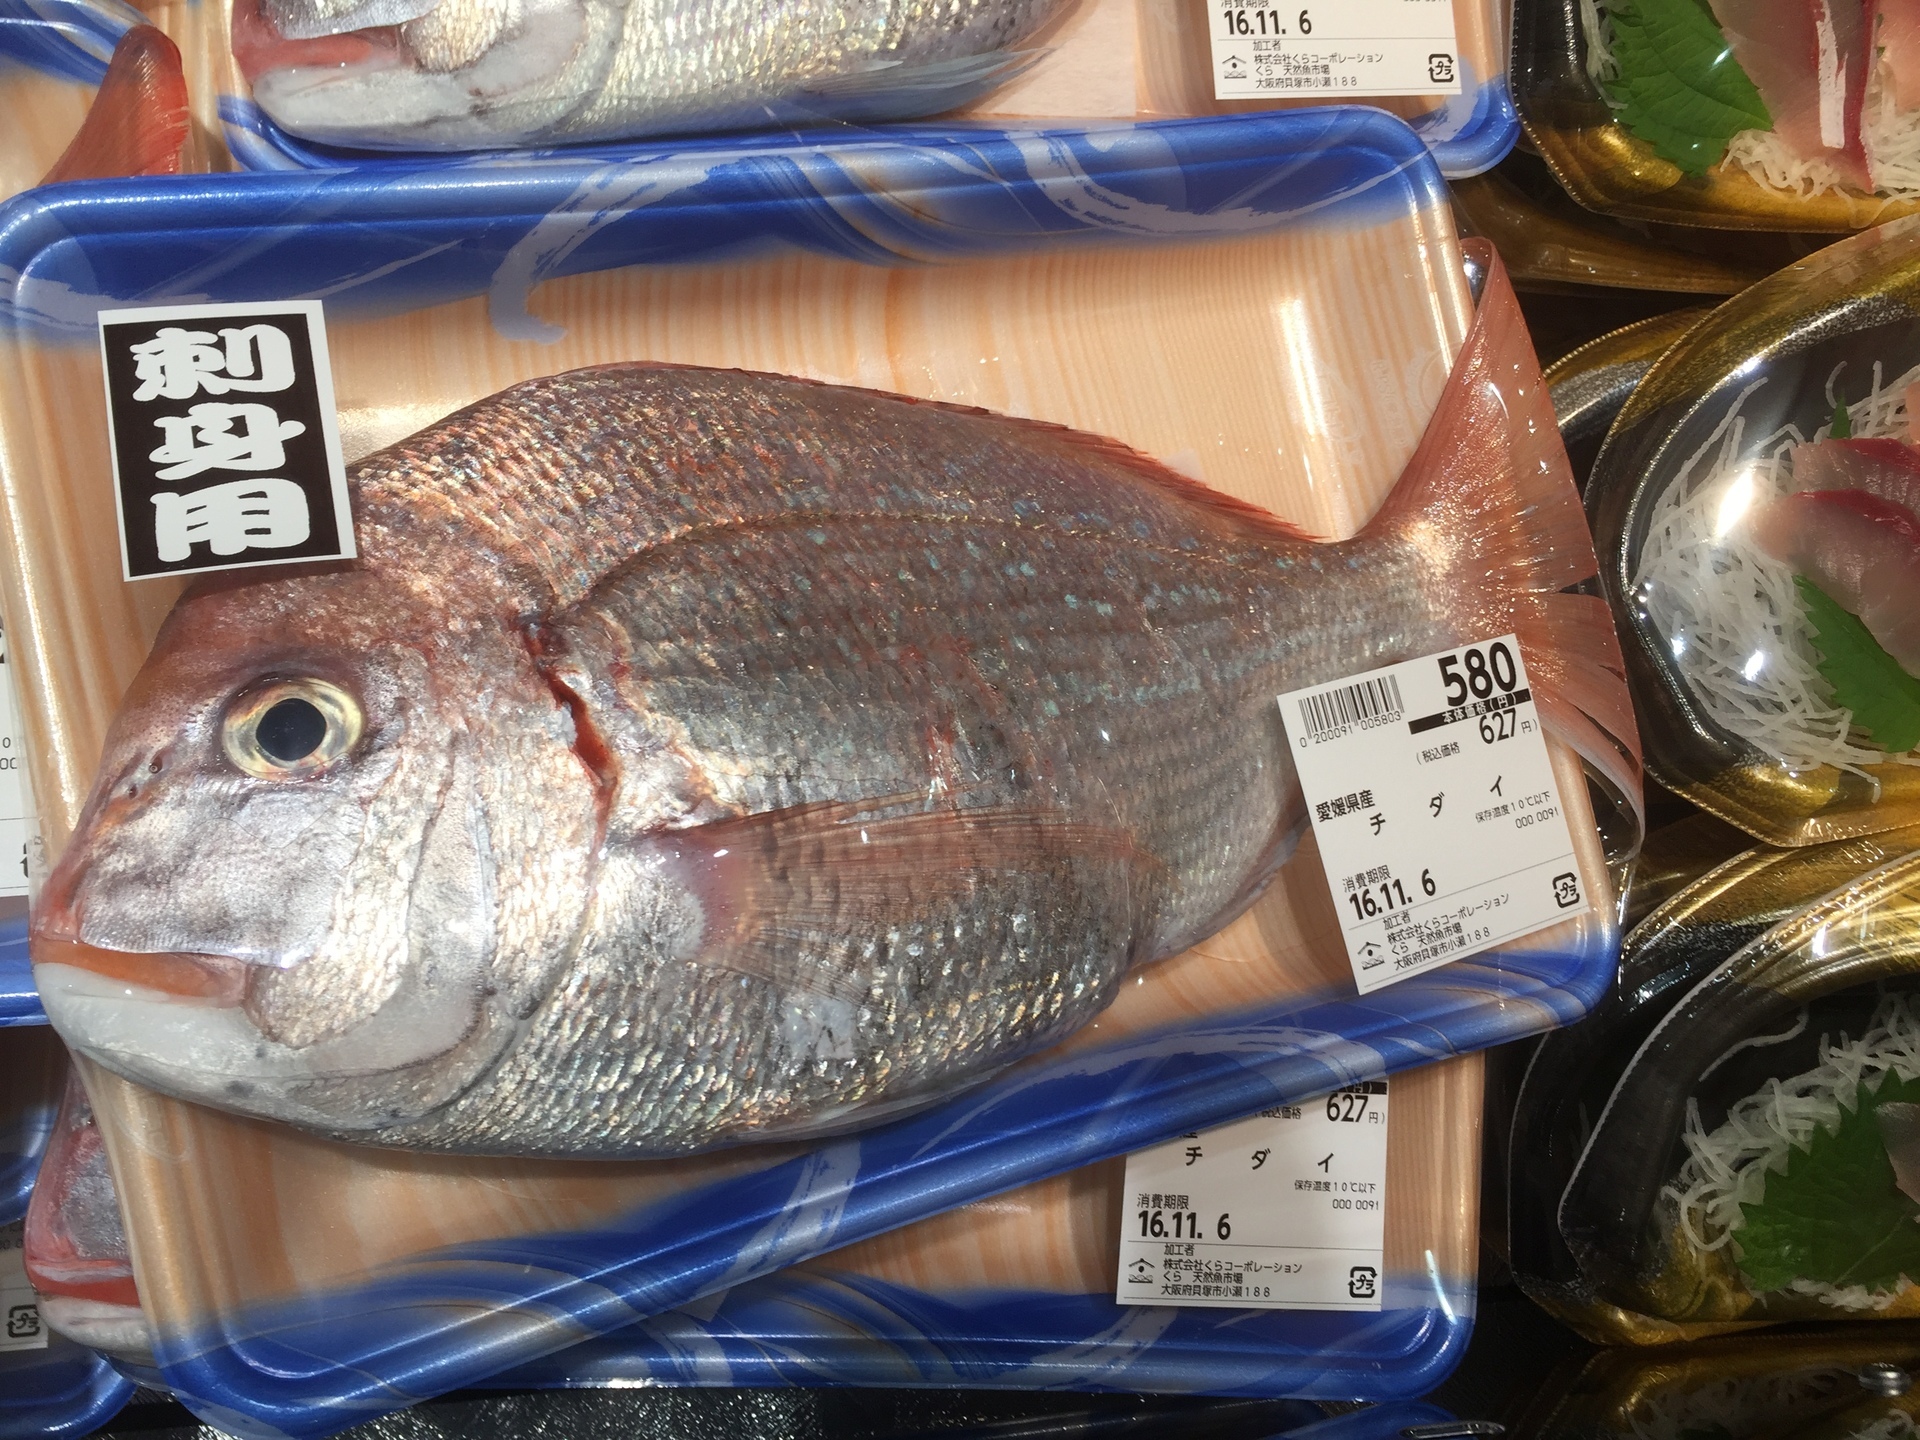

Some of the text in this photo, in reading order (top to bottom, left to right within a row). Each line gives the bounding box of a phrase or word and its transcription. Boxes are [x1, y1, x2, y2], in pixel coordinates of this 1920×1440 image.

[1253, 40, 1281, 52] 加工者
[1254, 53, 1383, 65] 株式会社くらコーポレーション
[130, 324, 310, 562] 刺身用
[1437, 642, 1517, 707] 580
[1479, 707, 1518, 745] 627
[1315, 789, 1376, 823] 愛媛県産
[1341, 864, 1392, 894] 消費期限
[1382, 909, 1412, 932] 加工者
[1387, 893, 1510, 944] 株式会社くらコーポレーション
[1327, 1093, 1369, 1122] 627
[1137, 1193, 1189, 1210] 消費期限
[1163, 1243, 1195, 1257] 加工者
[1163, 1258, 1303, 1274] 株式会社くらコーポレーション
